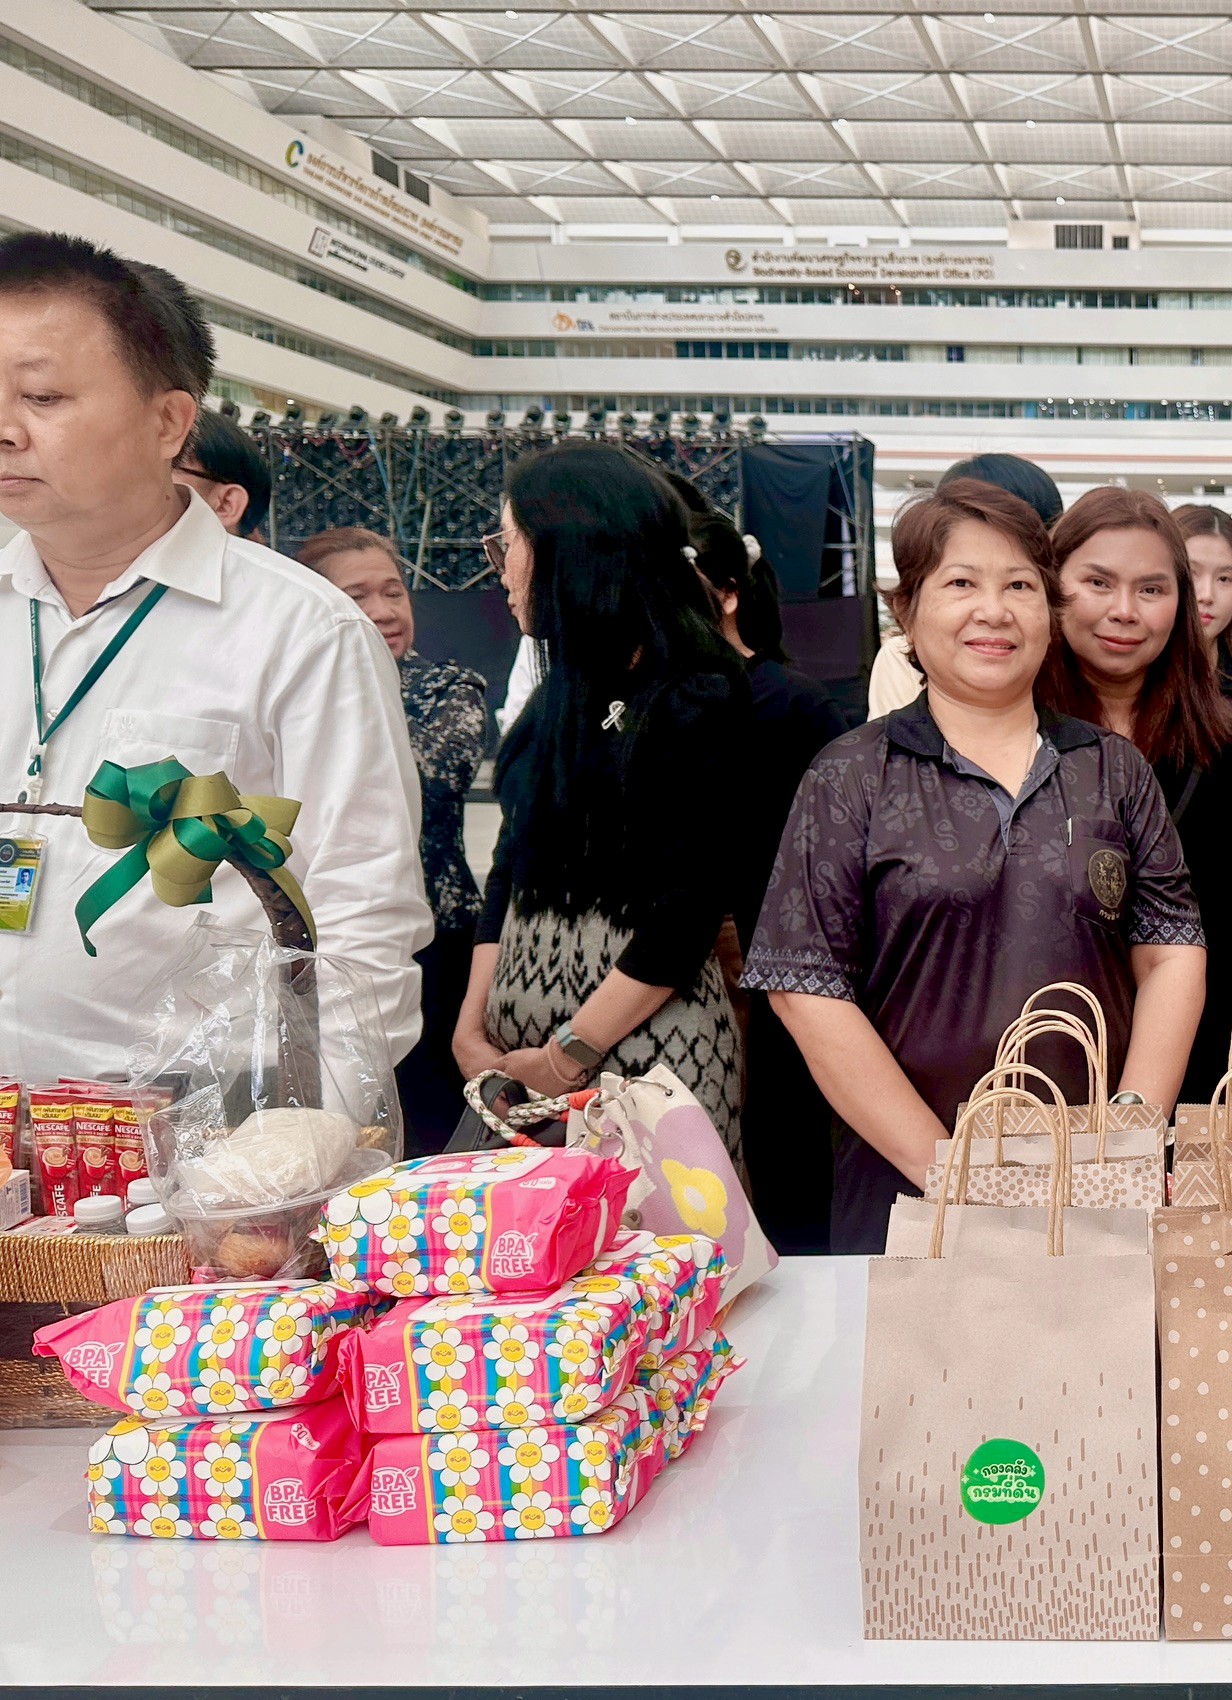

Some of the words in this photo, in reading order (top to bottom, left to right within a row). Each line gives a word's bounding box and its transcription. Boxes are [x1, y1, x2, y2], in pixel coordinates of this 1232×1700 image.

[499, 1237, 526, 1255] BPA
[492, 1257, 533, 1274] FREE
[69, 1348, 107, 1365] BPA
[87, 1369, 110, 1386] EE
[365, 1369, 391, 1386] PA
[365, 1388, 399, 1406] REE
[982, 1459, 1028, 1476] กองคลัง
[372, 1473, 410, 1490] BPA
[973, 1475, 1037, 1499] กรมที่ดิน
[270, 1484, 307, 1501] BPA
[371, 1492, 415, 1510] FREE
[268, 1501, 316, 1520] FREE
